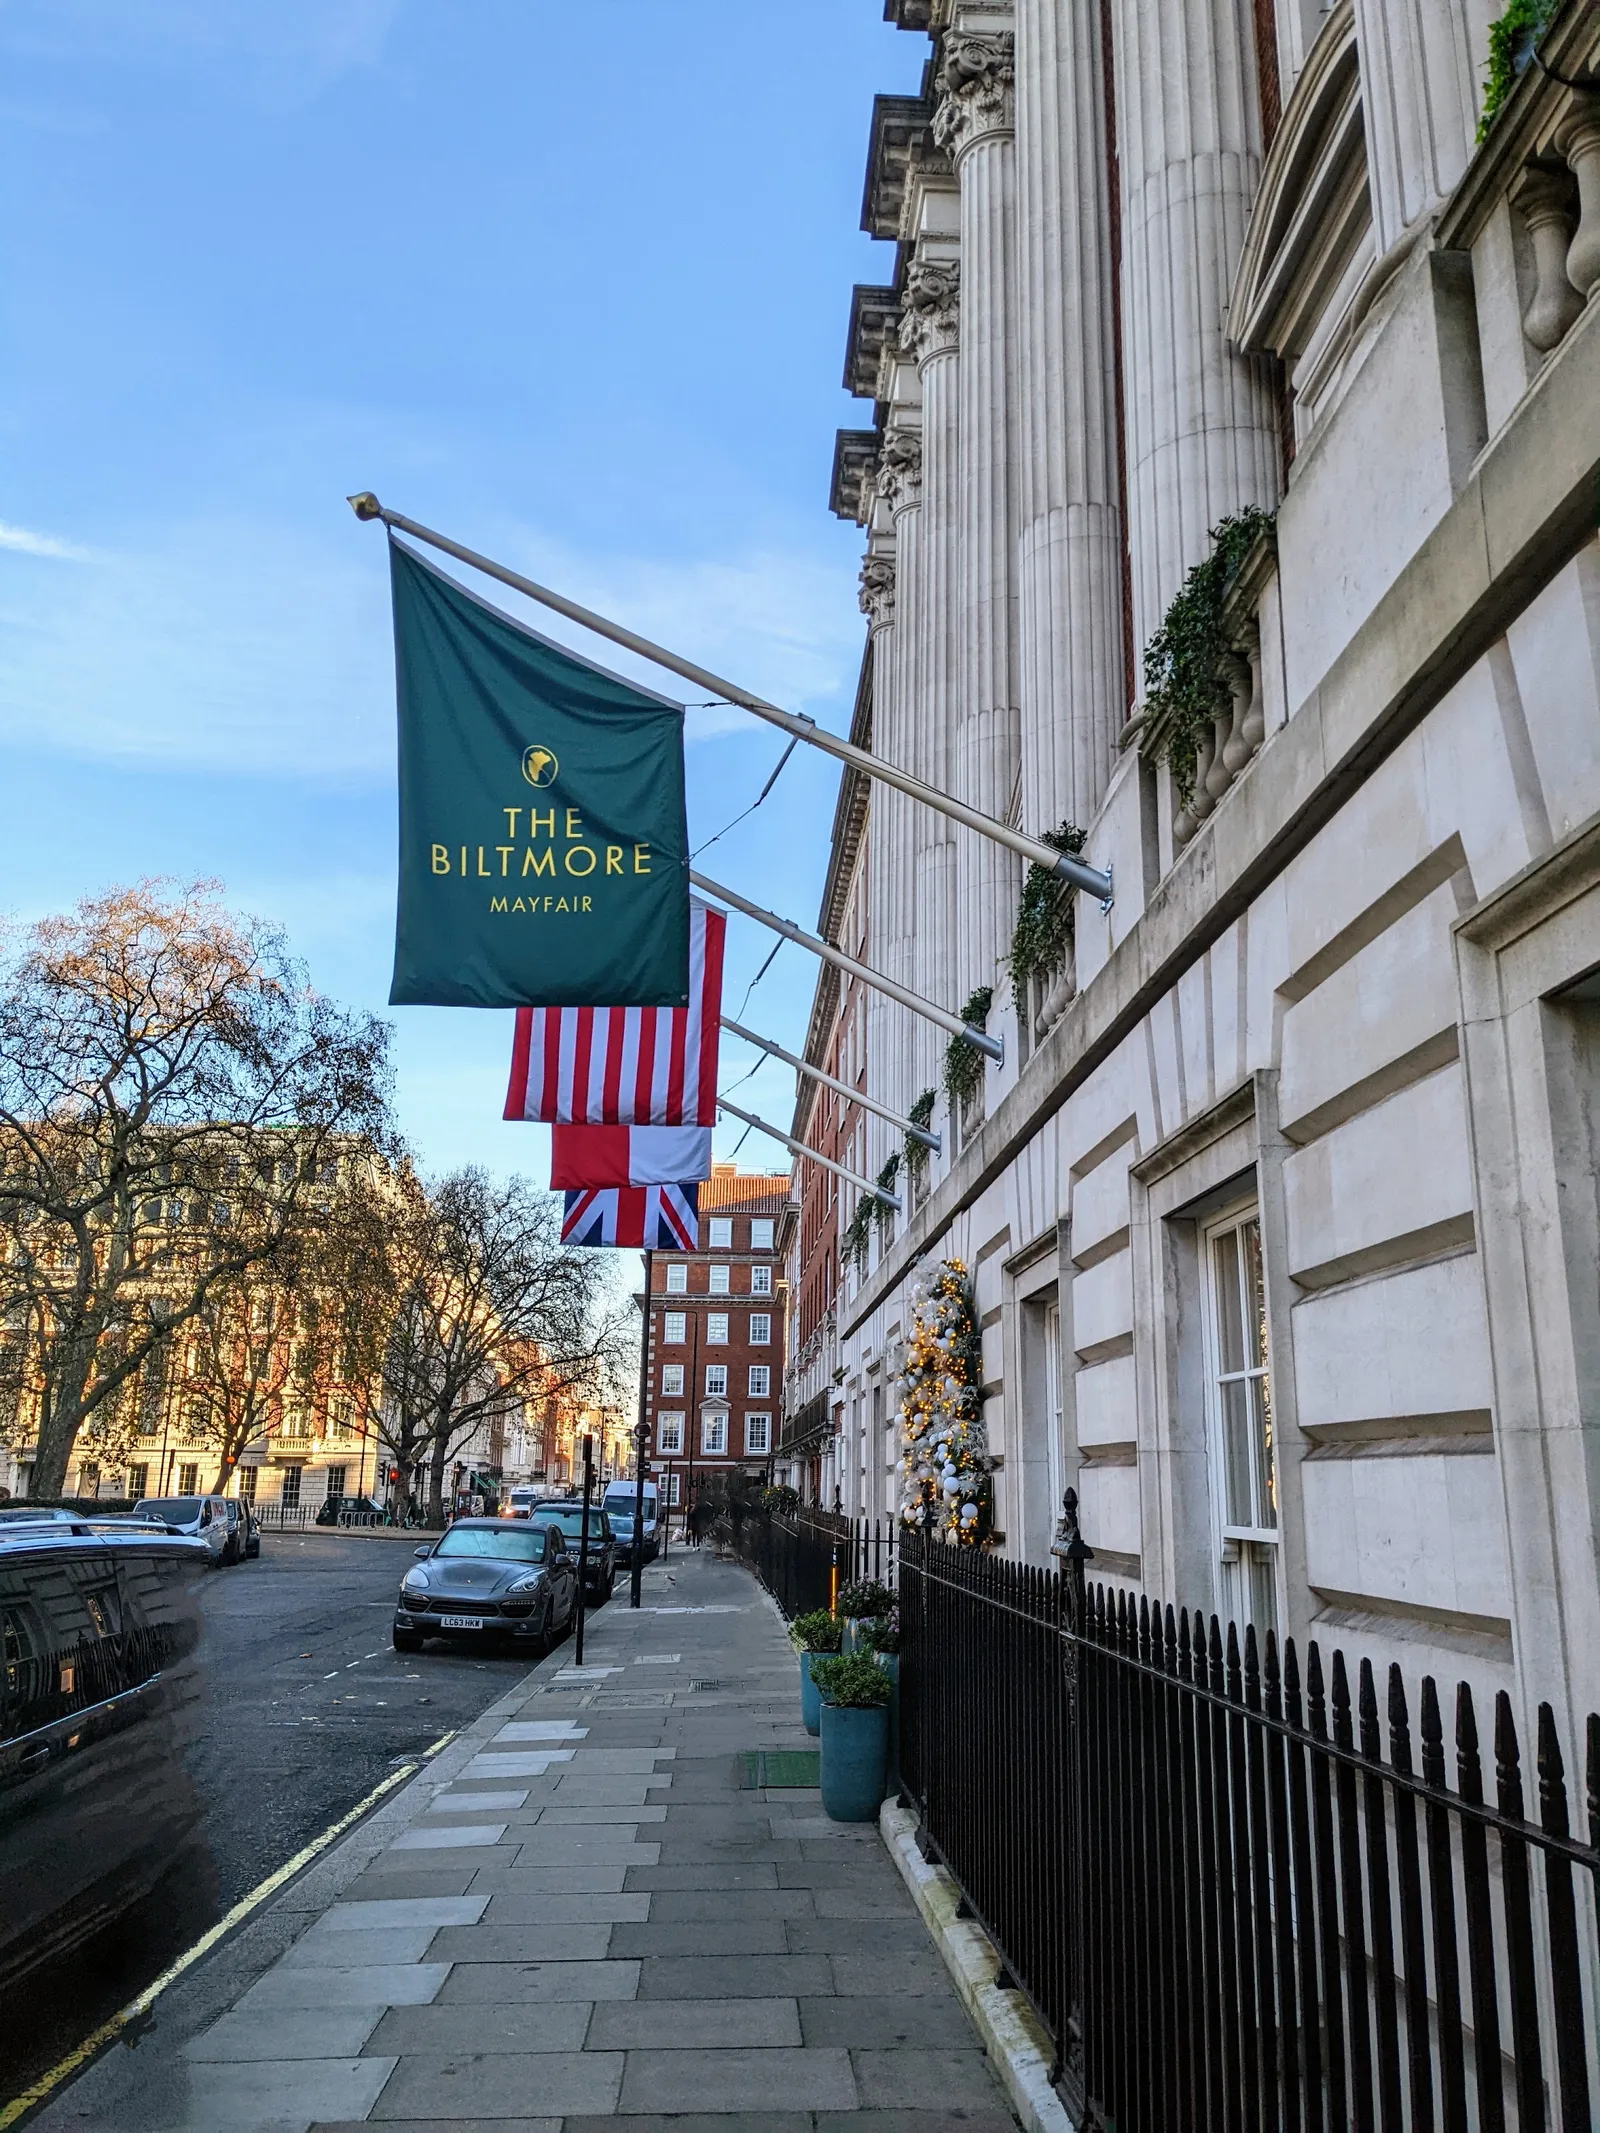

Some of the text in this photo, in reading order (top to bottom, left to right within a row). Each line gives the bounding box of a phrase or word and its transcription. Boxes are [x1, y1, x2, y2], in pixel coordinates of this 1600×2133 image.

[503, 807, 583, 838] THE
[431, 843, 652, 877] BILTMORE
[489, 896, 593, 913] MAYFAIR
[444, 1617, 464, 1627] LC63
